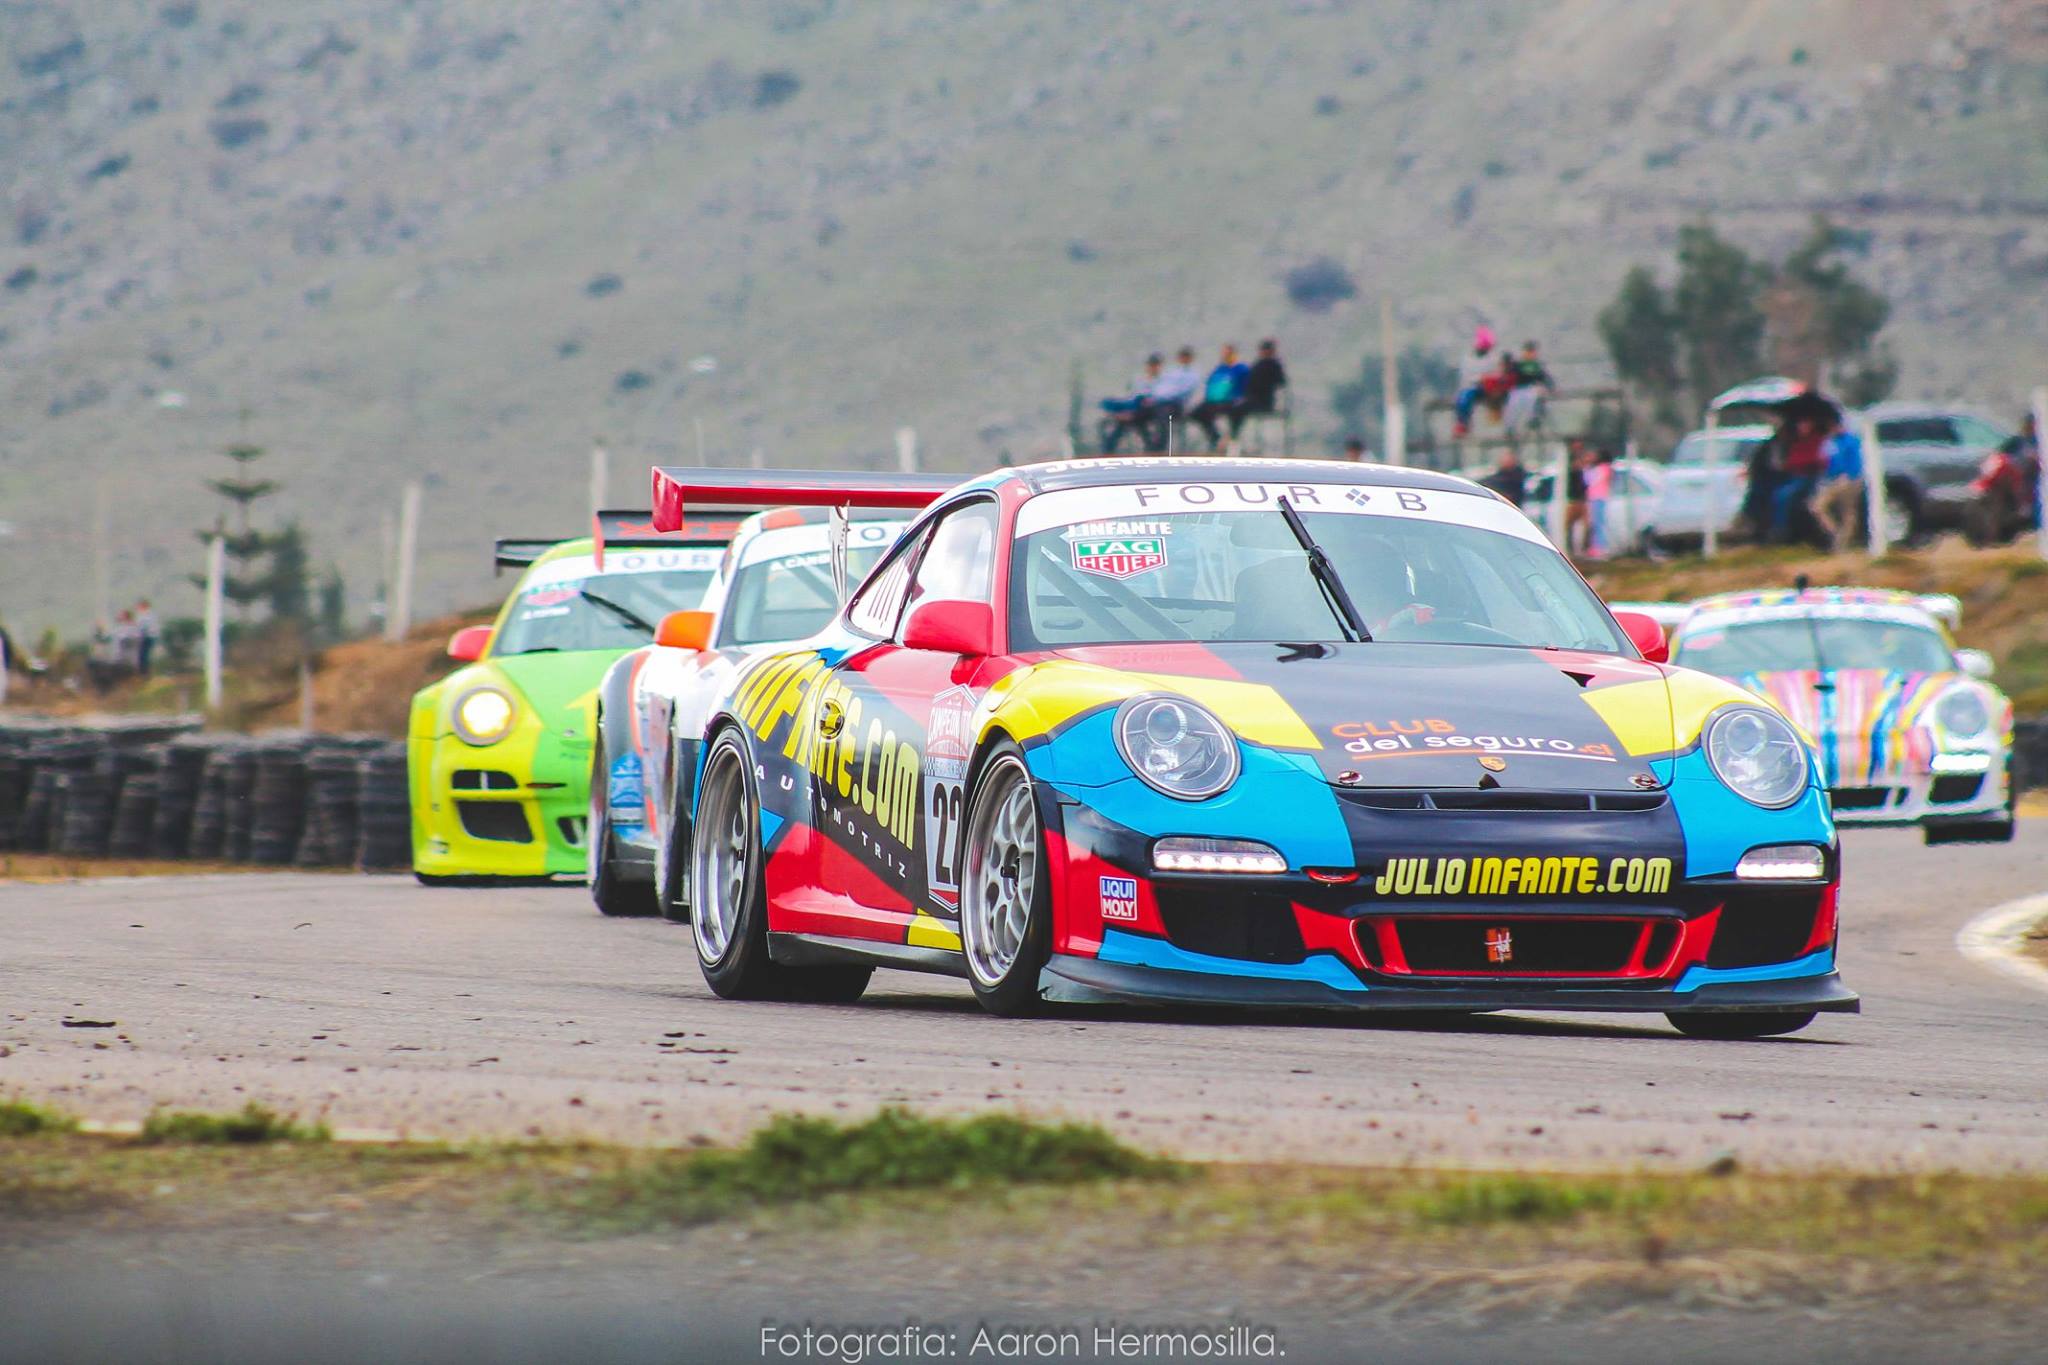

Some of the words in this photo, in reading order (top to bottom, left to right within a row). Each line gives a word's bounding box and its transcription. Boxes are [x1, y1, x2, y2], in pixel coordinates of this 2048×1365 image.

[1135, 485, 1320, 507] FOUR
[1396, 491, 1427, 512] B
[1081, 541, 1154, 555] TAG
[604, 553, 710, 571] OUR
[1082, 555, 1158, 574] HEUER
[1332, 719, 1456, 737] CLUB
[1344, 734, 1412, 753] del
[755, 765, 906, 878] AUTOMOTRIZ
[1102, 879, 1134, 899] LIQUI
[1102, 898, 1135, 917] MOLY
